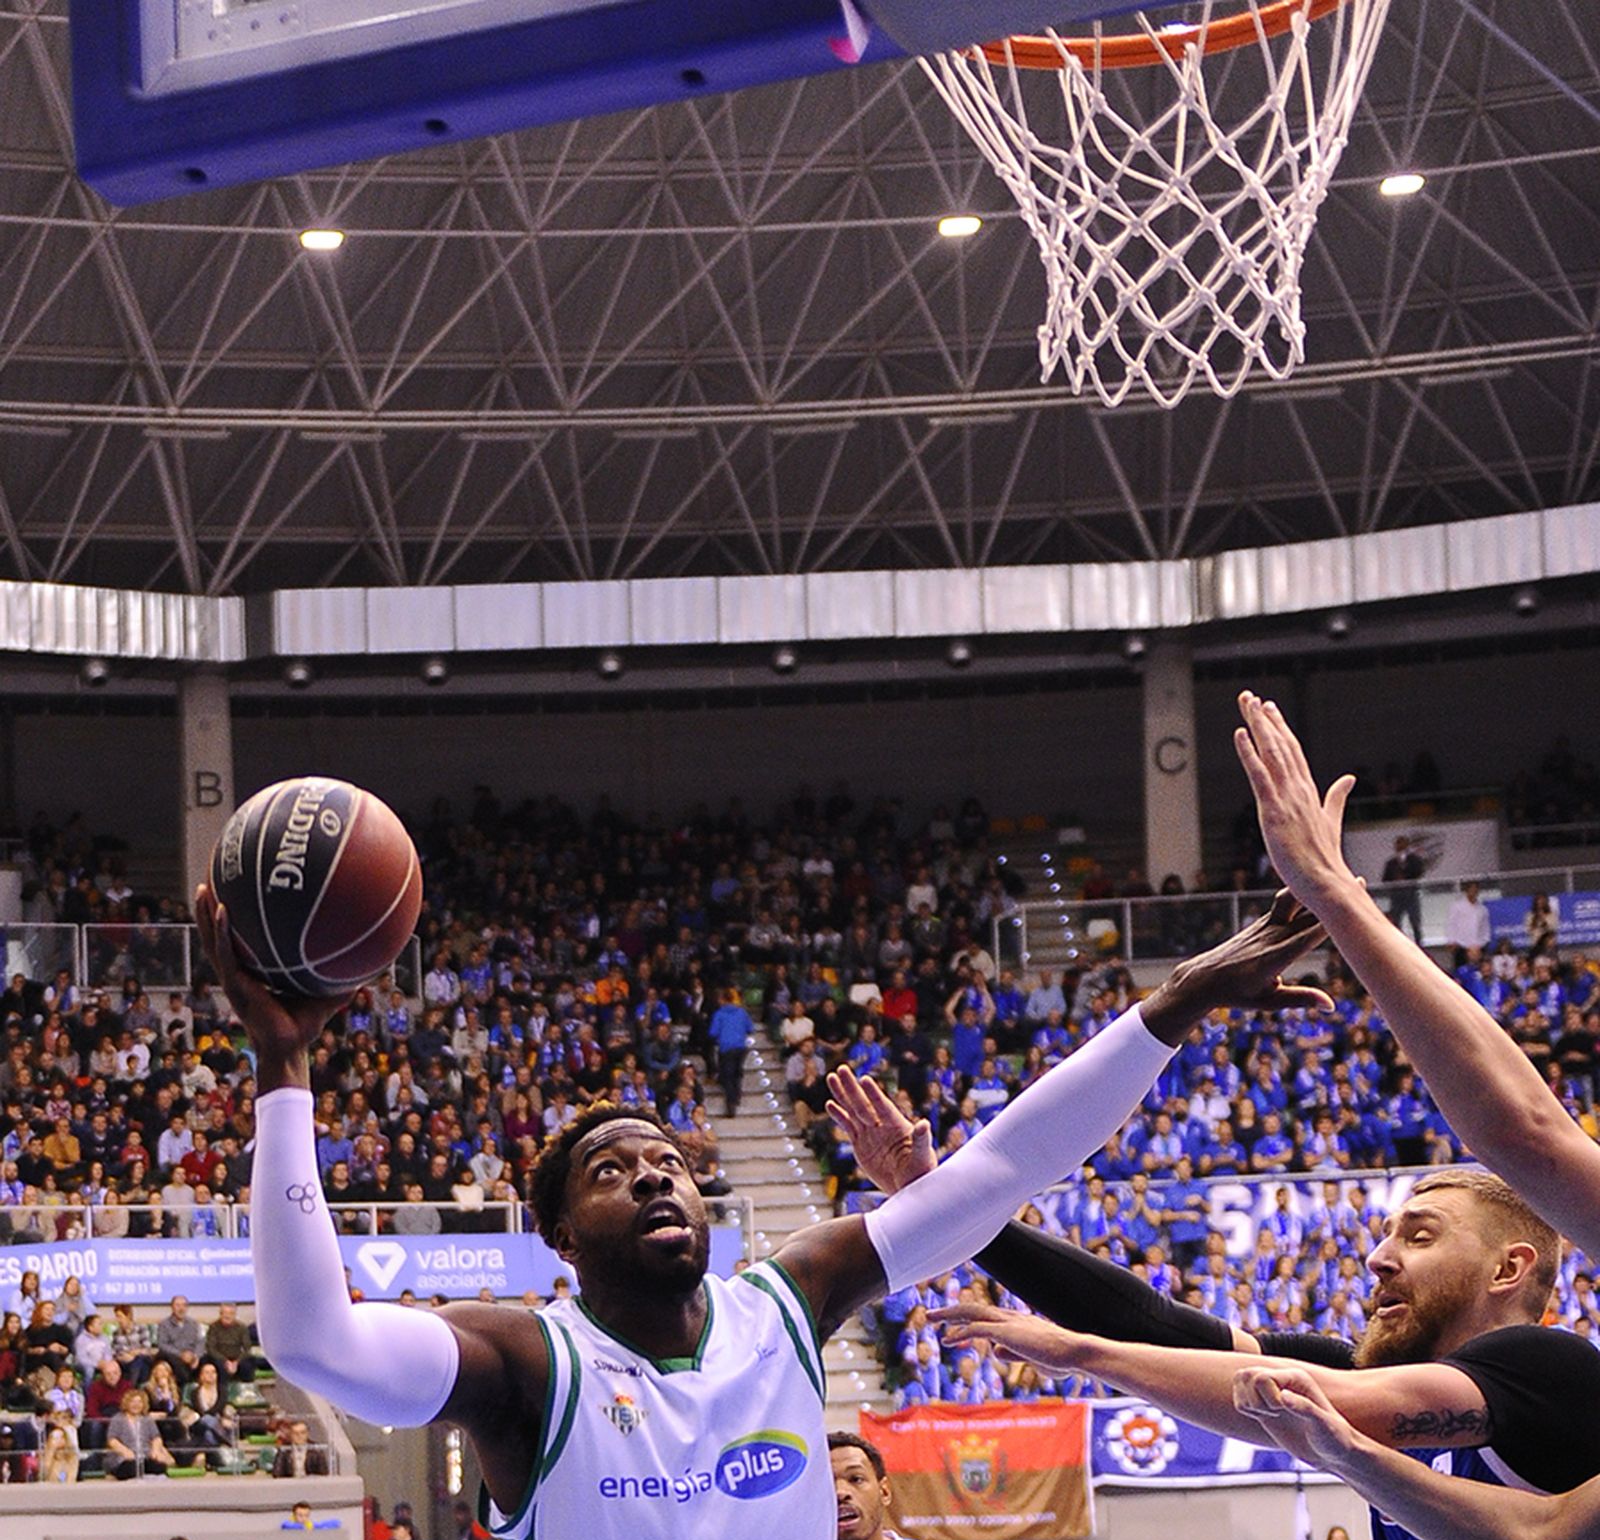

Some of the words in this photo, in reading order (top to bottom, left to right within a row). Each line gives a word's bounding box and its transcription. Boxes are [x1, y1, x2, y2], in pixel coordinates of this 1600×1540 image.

[1155, 737, 1187, 775] C
[195, 771, 223, 807] B
[27, 1249, 98, 1282] PARDO
[415, 1244, 506, 1270] valora
[416, 1272, 508, 1290] asociados
[599, 1467, 713, 1503] energía
[723, 1447, 785, 1491] plus
